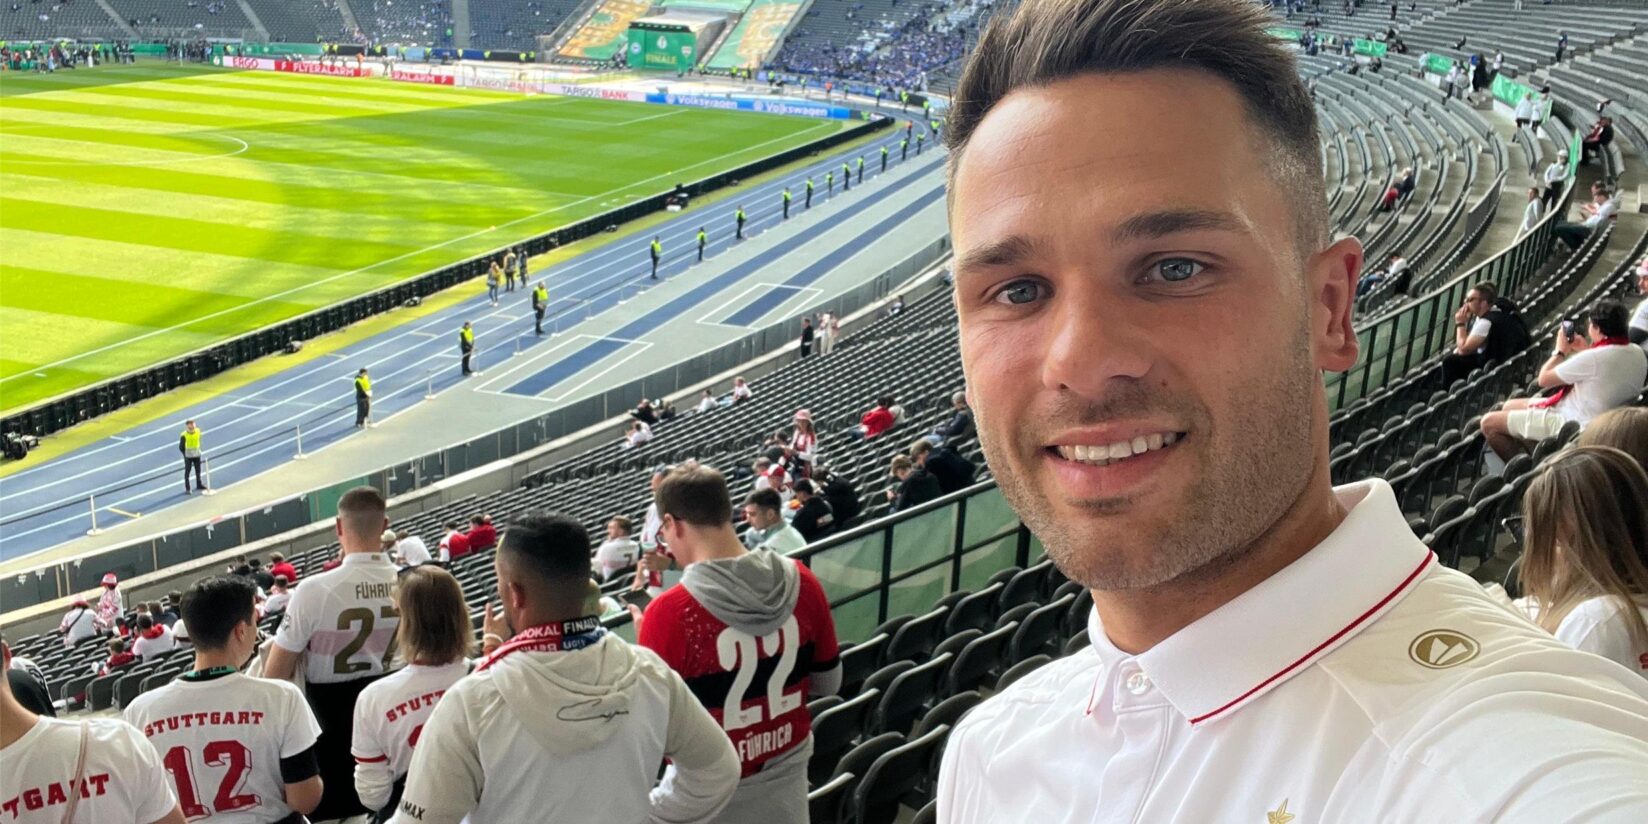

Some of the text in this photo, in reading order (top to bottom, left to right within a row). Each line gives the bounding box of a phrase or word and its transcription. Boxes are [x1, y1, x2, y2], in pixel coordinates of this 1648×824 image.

[232, 56, 259, 70] ERGO
[293, 61, 354, 77] FLYERALARM
[645, 53, 678, 65] FINALE
[677, 94, 738, 109] Volkswagen
[765, 101, 828, 117] Volkswagen
[333, 606, 402, 675] 27
[716, 613, 802, 731] 22
[144, 711, 264, 738] STUTTGART
[738, 722, 793, 763] FÜHRICH
[164, 740, 262, 818] 12
